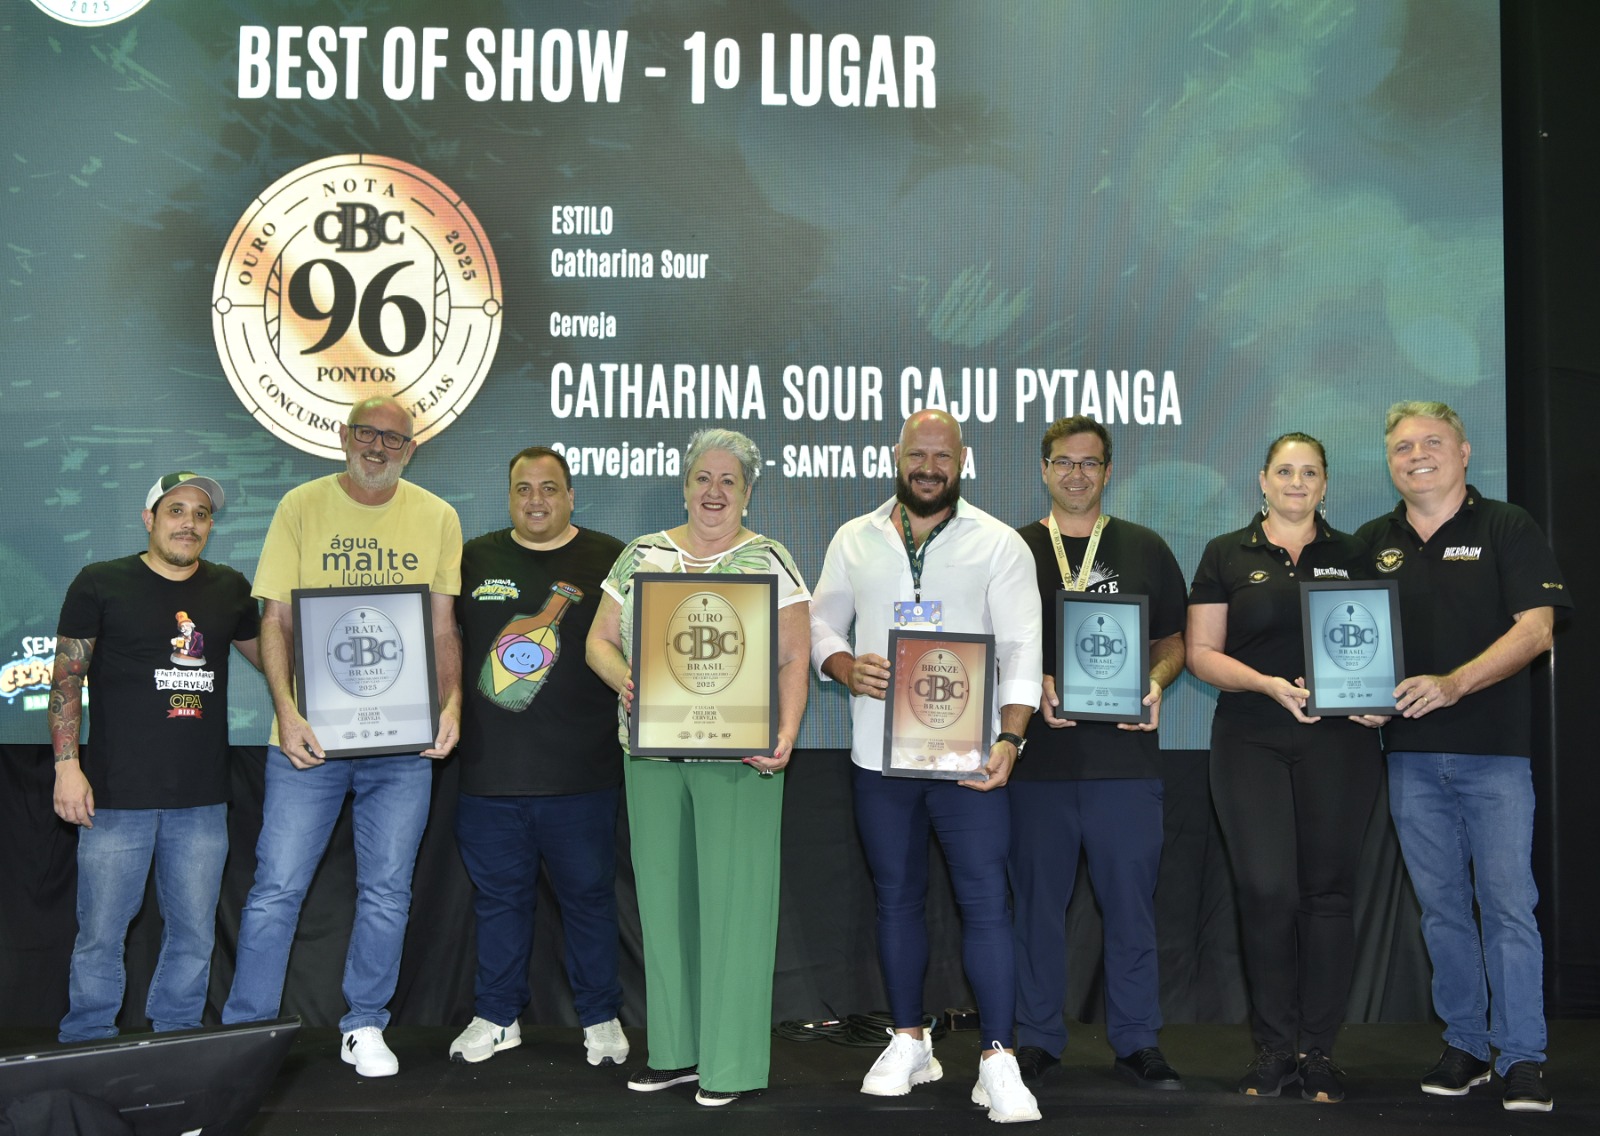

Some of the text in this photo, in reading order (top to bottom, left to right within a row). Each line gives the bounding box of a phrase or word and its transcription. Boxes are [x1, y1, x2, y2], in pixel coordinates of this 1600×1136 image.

[237, 25, 368, 101] BEST
[382, 26, 449, 101] OF
[465, 28, 629, 103] SHOW
[644, 67, 666, 78] -
[761, 32, 937, 109] LUGAR
[322, 178, 395, 198] NOTA
[313, 201, 406, 253] CBC
[551, 205, 614, 236] ESTILO
[238, 221, 276, 286] OURO
[445, 229, 477, 282] 2025
[551, 247, 709, 279] Catharina Sour
[288, 258, 427, 358] 96
[549, 311, 617, 340] Cerveja
[316, 366, 397, 383] PONTOS
[258, 374, 454, 434] CONCURSO VEJAS
[550, 362, 1182, 425] CATHARINA SOUR CAJU PYTANGA
[782, 444, 857, 479] SANTA
[330, 534, 378, 552] água
[1443, 545, 1483, 559] BIERBAUM
[322, 548, 419, 571] malte
[342, 568, 404, 587] lúpulo
[344, 624, 384, 635] PRATA
[687, 613, 723, 623] OURO
[22, 636, 58, 659] SEM
[673, 625, 738, 661] CBC
[1079, 633, 1124, 658] CBC
[1328, 623, 1375, 648] CBC
[334, 636, 398, 668] CBC
[348, 668, 386, 677] BRASIL
[687, 663, 725, 671] BRASIL
[921, 664, 959, 674] BRONZE
[157, 679, 213, 691] DE CERVEJAS
[914, 674, 965, 703] CBC
[169, 693, 203, 709] OPA
[923, 703, 952, 711] BRASIL
